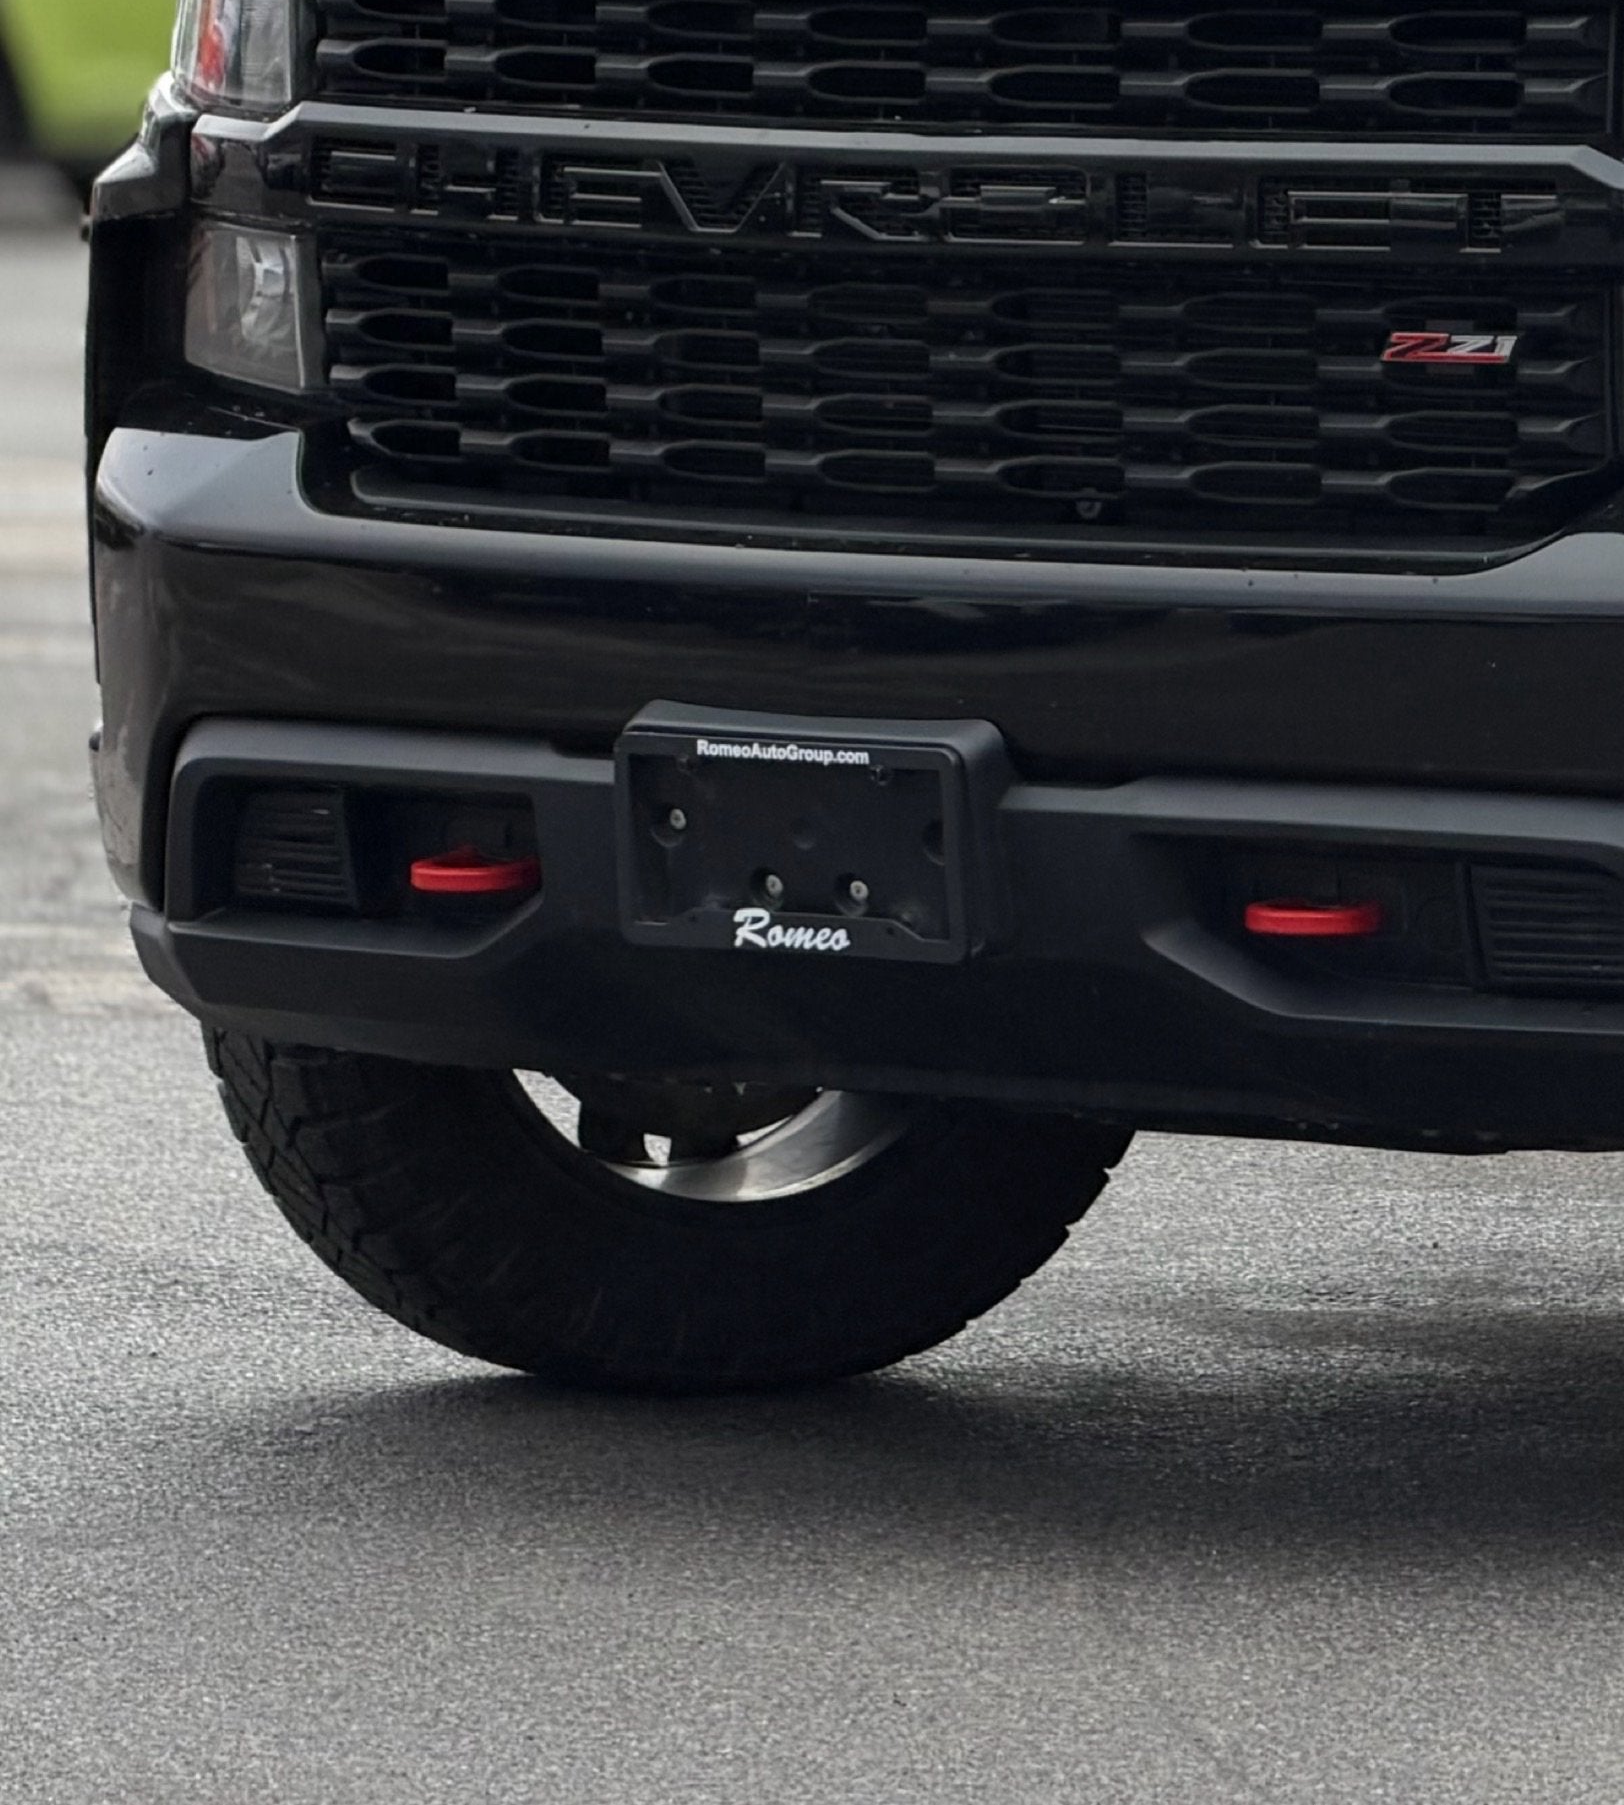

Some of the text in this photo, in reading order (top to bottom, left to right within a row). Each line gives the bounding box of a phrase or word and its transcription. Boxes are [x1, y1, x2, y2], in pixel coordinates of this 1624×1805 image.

[303, 132, 1560, 254] CHEVROLET
[1381, 332, 1518, 363] Z71
[696, 739, 870, 765] RomeoAutoGroup.com
[733, 907, 851, 951] Romeo
